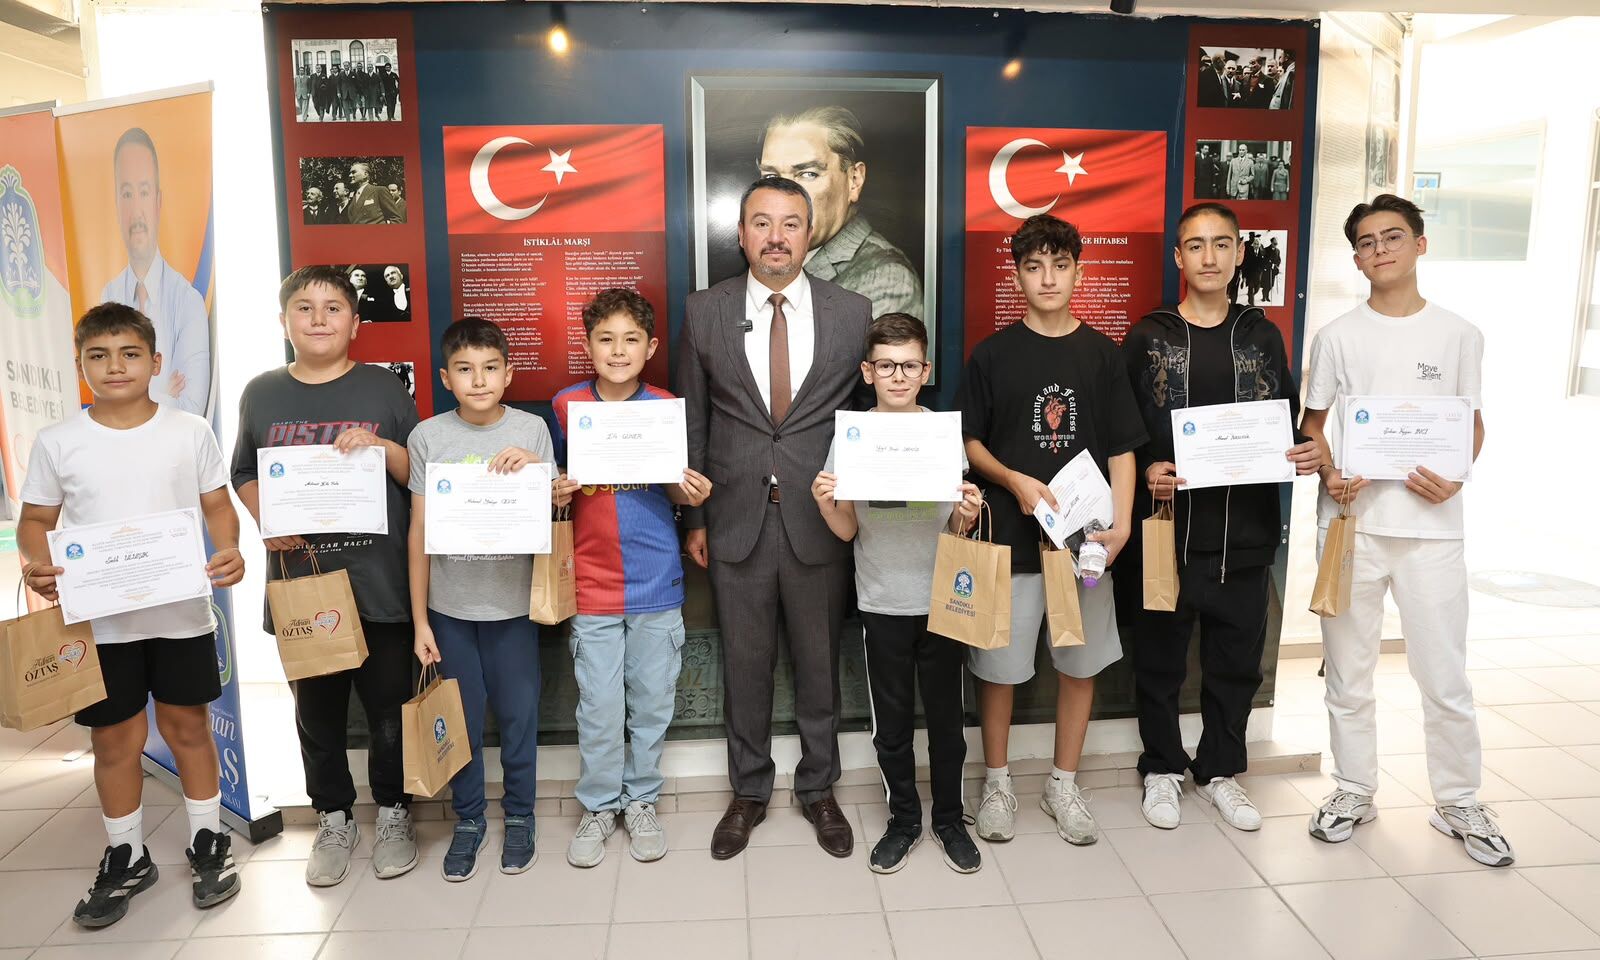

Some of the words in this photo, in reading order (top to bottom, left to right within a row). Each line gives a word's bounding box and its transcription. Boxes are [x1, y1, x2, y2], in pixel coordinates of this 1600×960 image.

[524, 237, 562, 246] İSTİKLÂL
[564, 238, 591, 246] MARŞI
[1093, 236, 1128, 244] HİTABESİ
[1417, 362, 1438, 372] Move
[6, 359, 62, 393] SANDIKLI
[1422, 370, 1441, 380] Silent
[10, 391, 64, 421] BELEDİYESİ
[1032, 394, 1045, 433] Strong
[1043, 383, 1060, 395] and
[1060, 388, 1078, 432] Fearless
[950, 598, 974, 609] SANDIKLI
[945, 604, 976, 617] BELEDİYESİ
[282, 626, 313, 637] ÖZTAŞ
[24, 661, 59, 682] ÖZTAŞ
